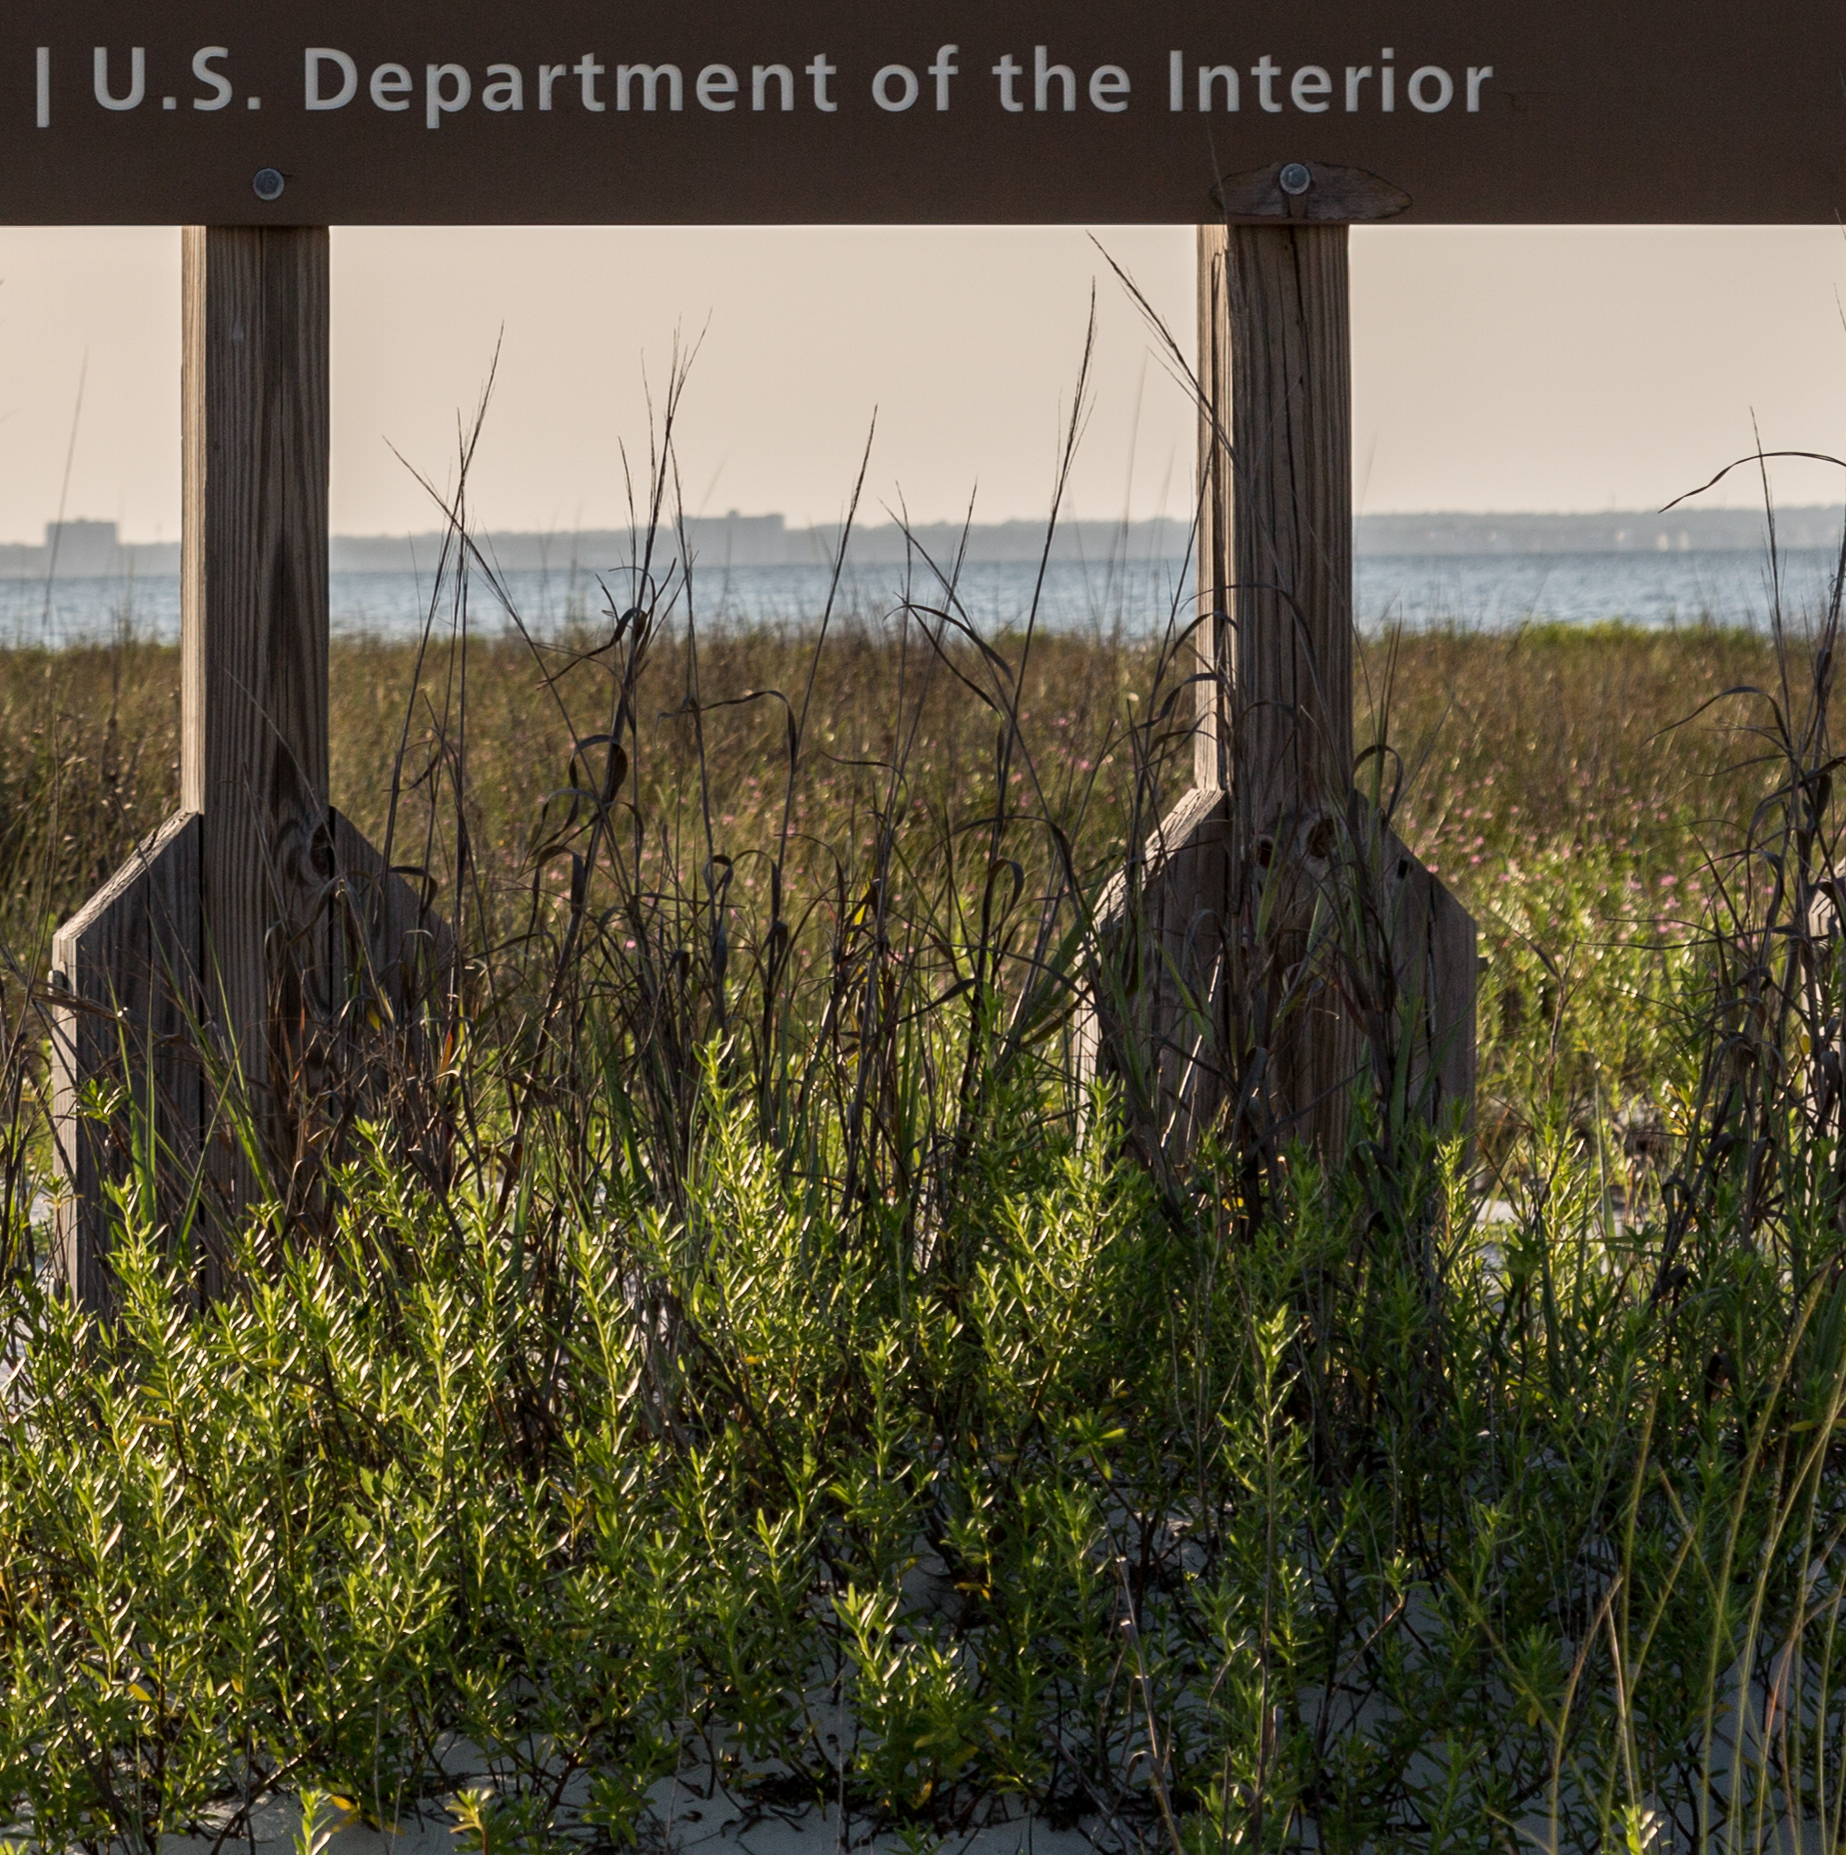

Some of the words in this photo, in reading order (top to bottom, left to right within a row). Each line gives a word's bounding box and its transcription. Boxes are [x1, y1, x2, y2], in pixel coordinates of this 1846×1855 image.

[94, 46, 261, 112] U.S.
[305, 48, 837, 129] Department
[872, 45, 958, 112] of
[992, 46, 1130, 113] the
[1169, 48, 1493, 114] Interior
